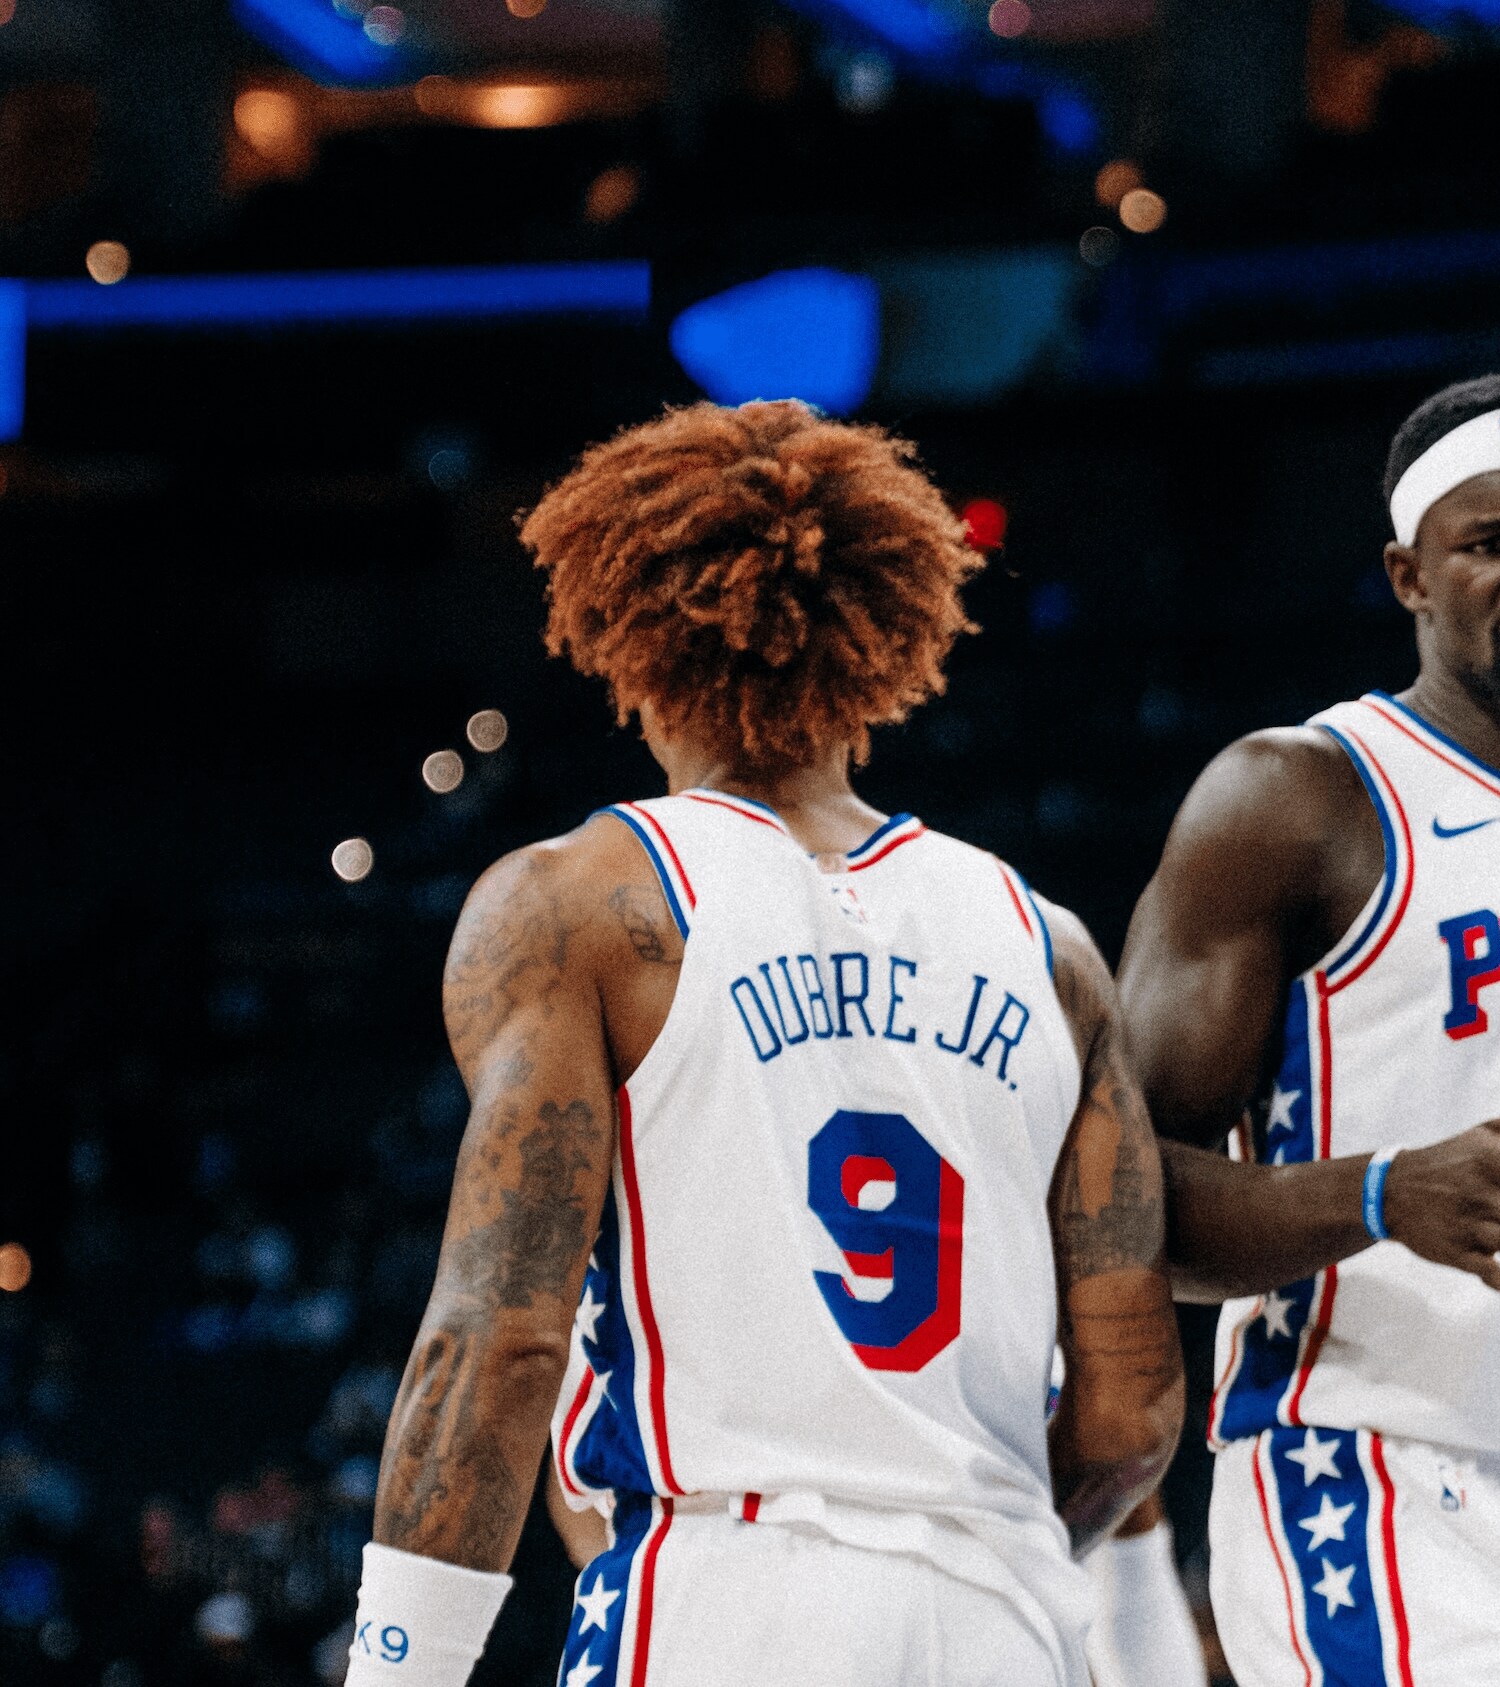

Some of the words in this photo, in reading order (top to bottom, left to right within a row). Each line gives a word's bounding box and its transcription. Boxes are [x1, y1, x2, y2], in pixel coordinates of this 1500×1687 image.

[729, 951, 919, 1064] OUBRE
[934, 974, 1031, 1091] JR.
[807, 1108, 965, 1373] 9
